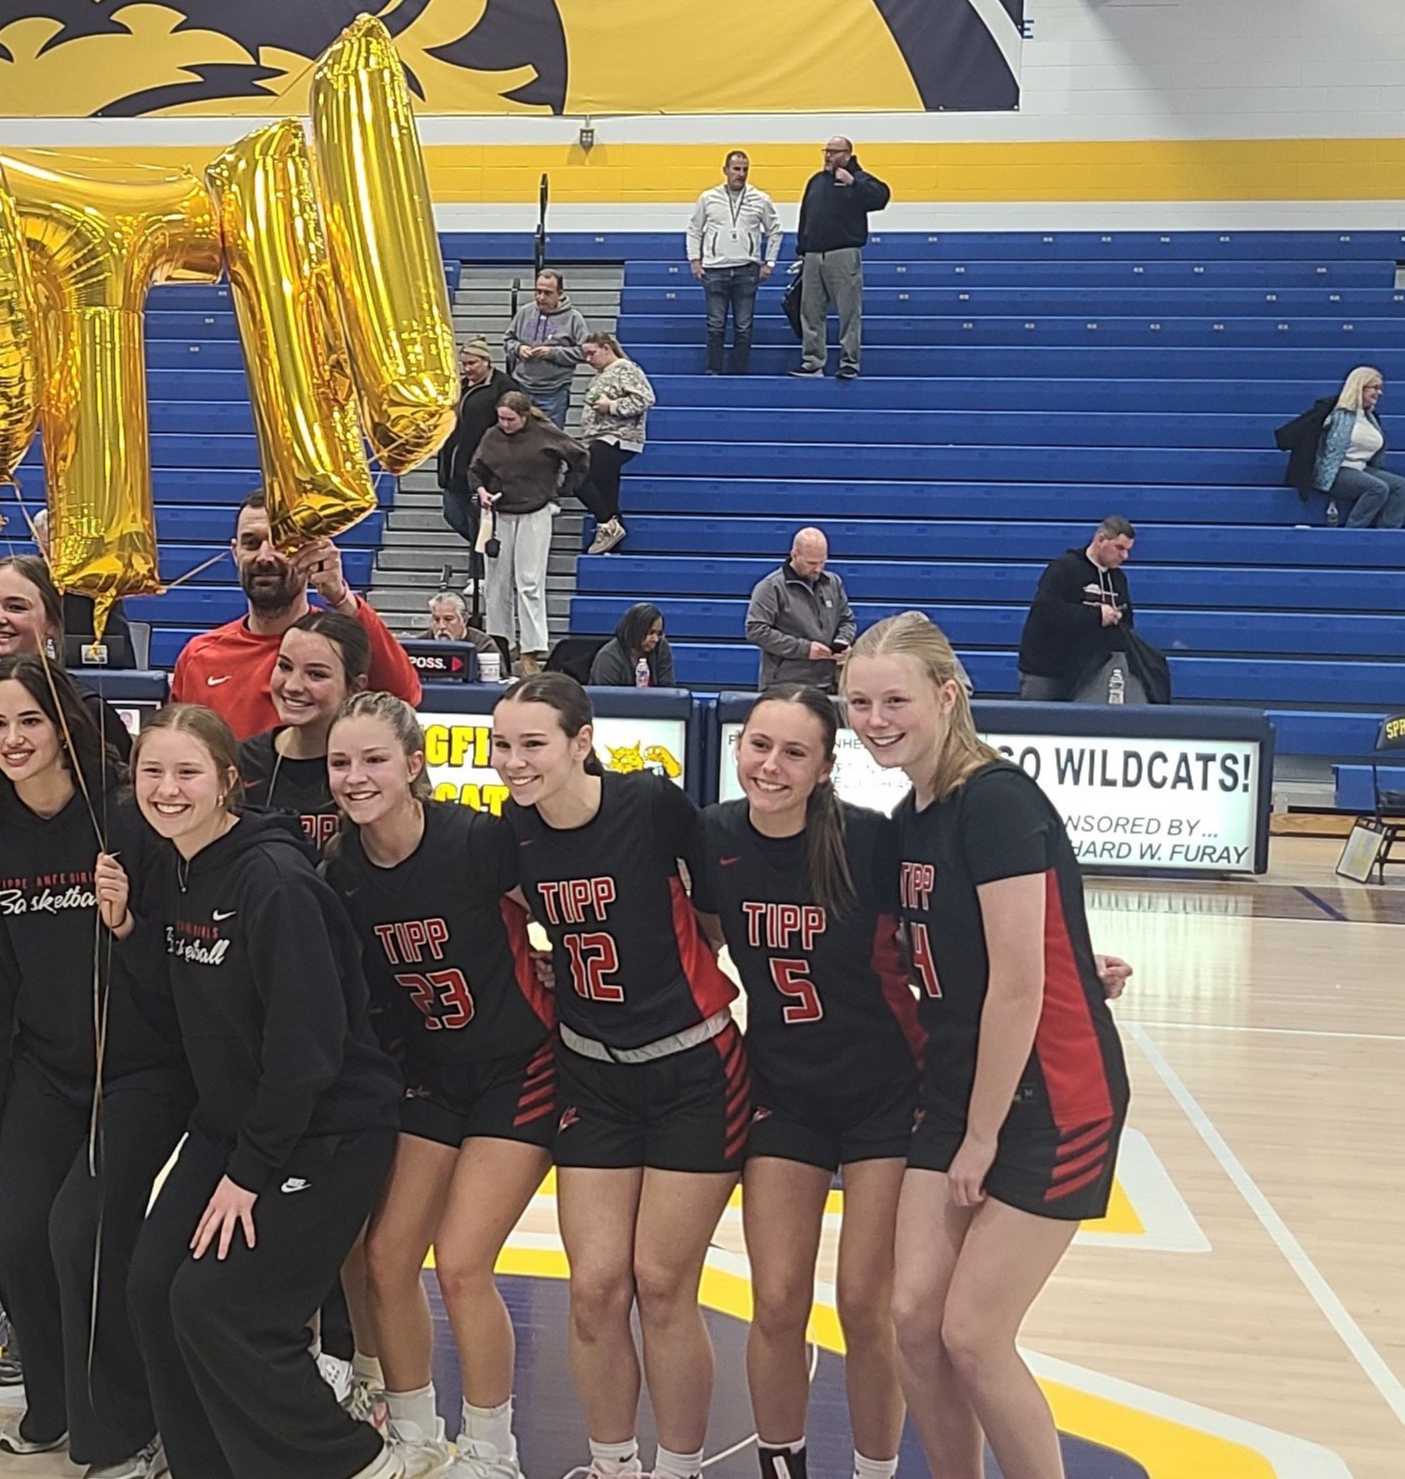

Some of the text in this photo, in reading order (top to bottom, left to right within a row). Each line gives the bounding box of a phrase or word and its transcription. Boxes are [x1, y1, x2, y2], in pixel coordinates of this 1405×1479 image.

[998, 745, 1251, 793] O WILDCATS!
[1065, 815, 1161, 836] NSORED
[1074, 840, 1249, 864] HARD W. FURAY
[538, 877, 616, 925] TIPP
[900, 862, 935, 910] TIPP
[374, 918, 449, 964] TIPP
[743, 902, 826, 950] TIPP
[564, 932, 624, 1002] 12
[769, 957, 823, 1024] 5
[395, 968, 474, 1030] 23
